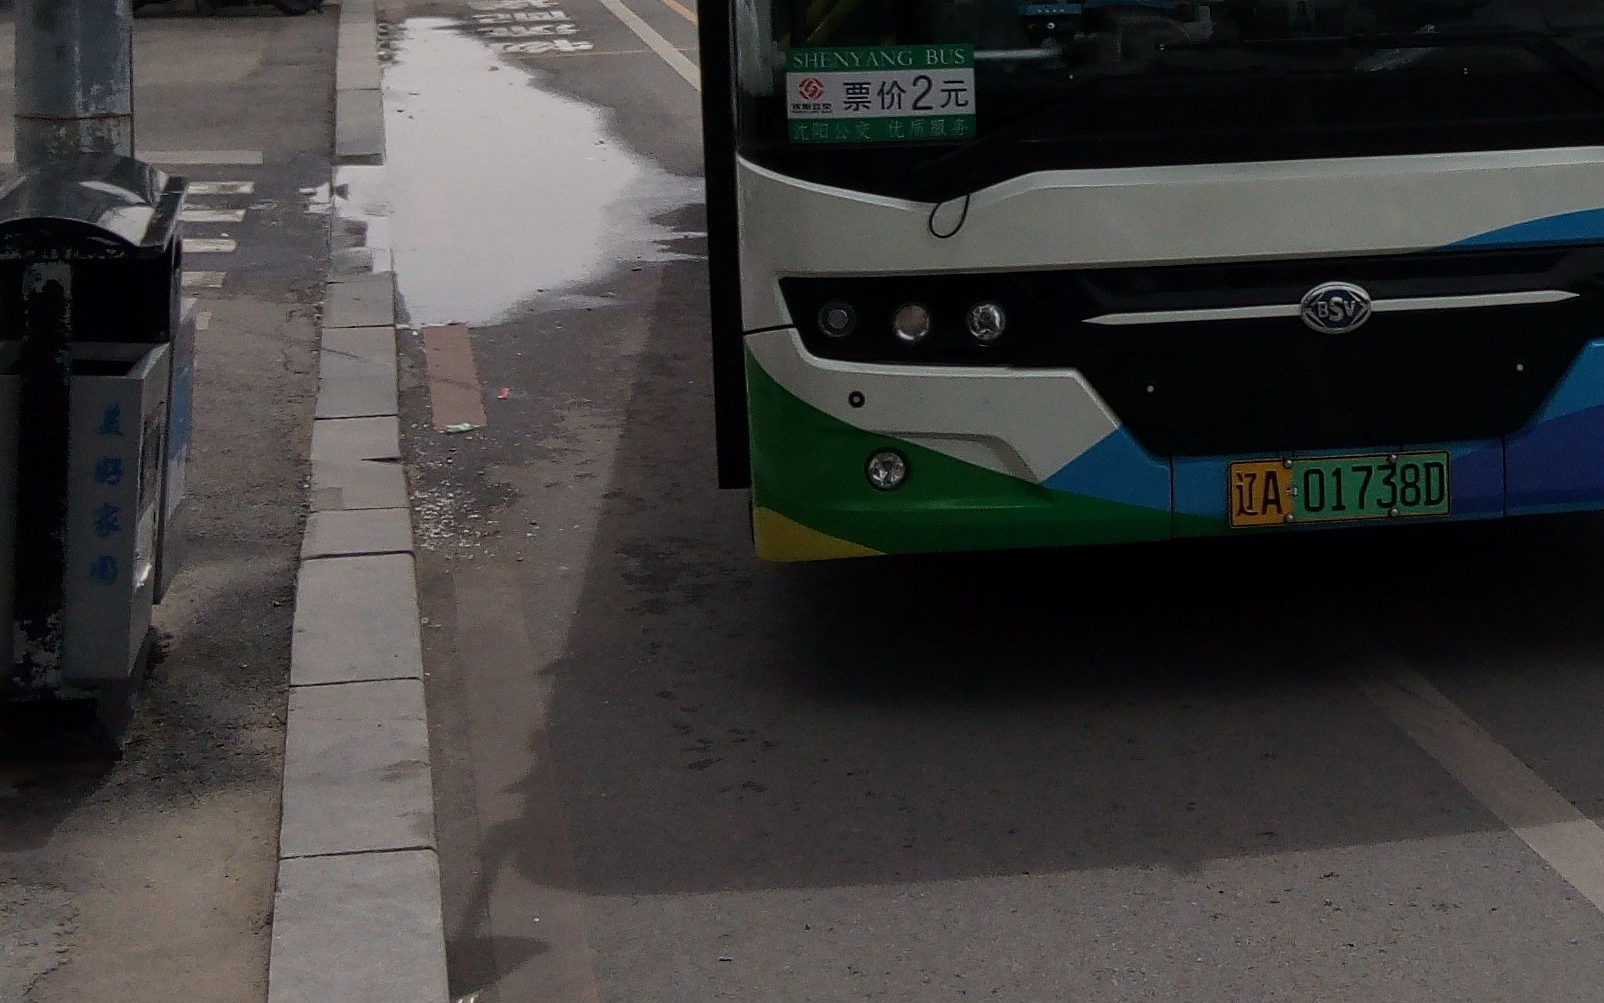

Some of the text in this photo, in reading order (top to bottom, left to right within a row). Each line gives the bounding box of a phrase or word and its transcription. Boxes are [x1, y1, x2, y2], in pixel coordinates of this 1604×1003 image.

[793, 48, 966, 69] SHENYANG BUS
[843, 75, 969, 112] 票价2元
[1317, 297, 1357, 322] BSV
